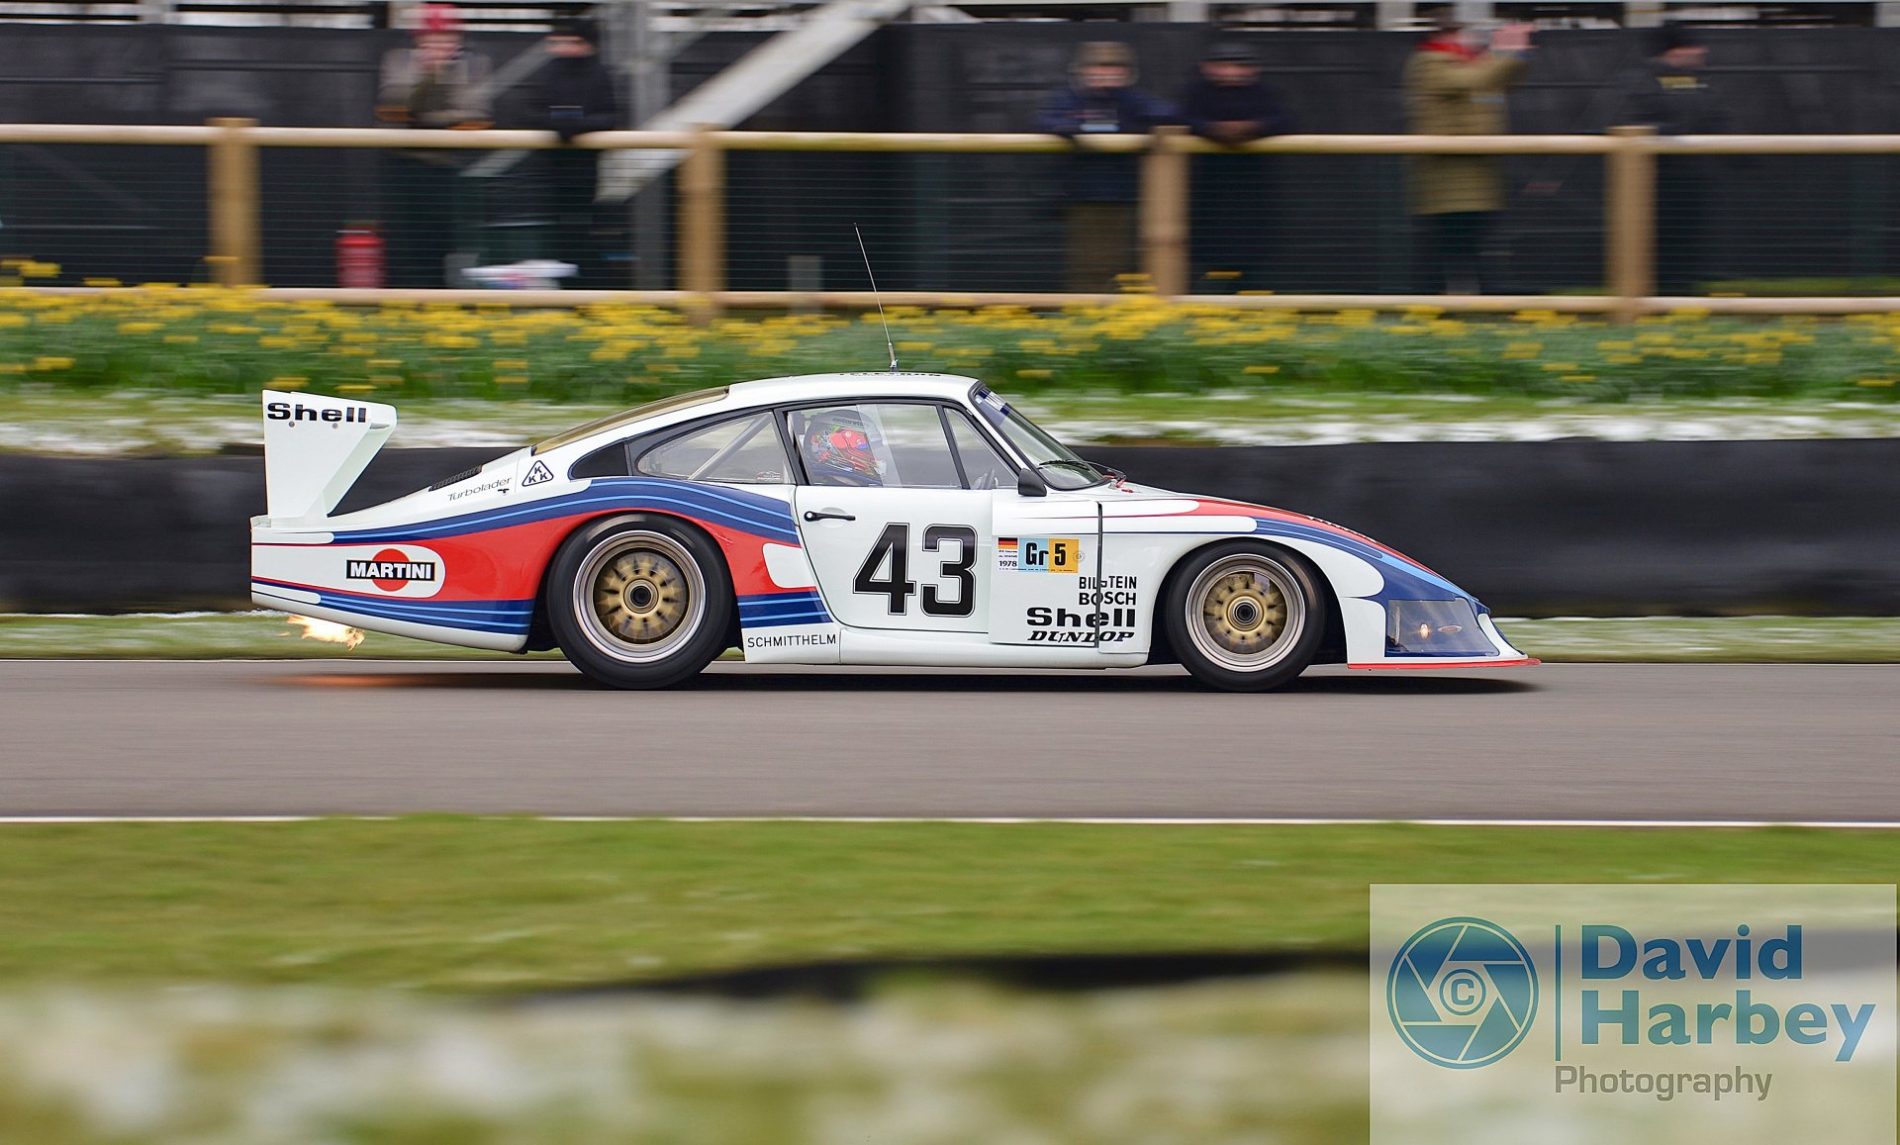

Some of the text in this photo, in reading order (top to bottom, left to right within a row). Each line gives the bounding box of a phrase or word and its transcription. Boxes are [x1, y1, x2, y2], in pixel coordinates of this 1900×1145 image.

[267, 402, 367, 423] Shell
[448, 477, 512, 501] Turbolader
[1025, 542, 1067, 566] Gr 5
[350, 561, 432, 579] MARTINI
[852, 522, 978, 618] 43
[1079, 591, 1137, 606] BOSCH
[1026, 607, 1136, 628] Shell
[747, 633, 836, 648] SCHMITTHELM
[1027, 630, 1135, 643] DUNLOP
